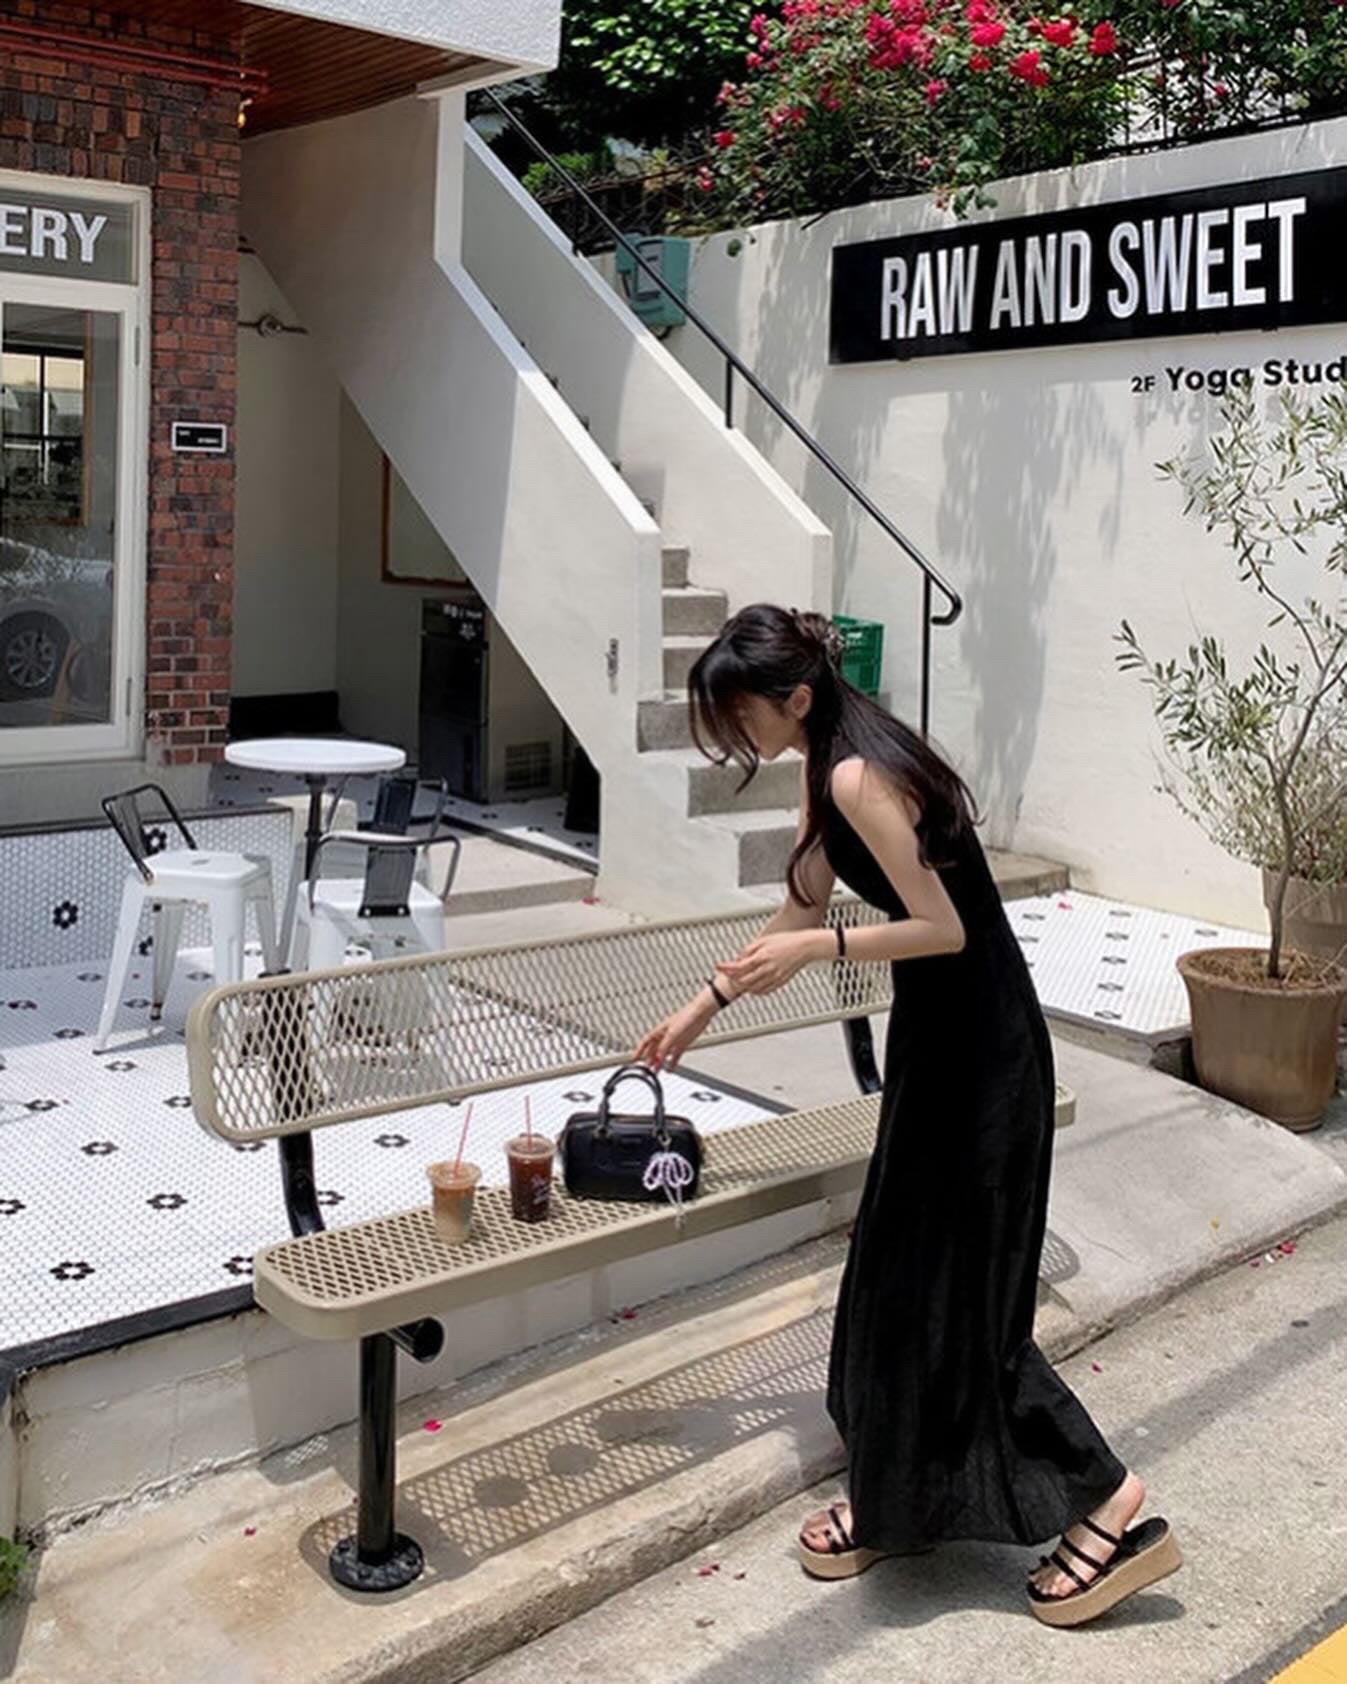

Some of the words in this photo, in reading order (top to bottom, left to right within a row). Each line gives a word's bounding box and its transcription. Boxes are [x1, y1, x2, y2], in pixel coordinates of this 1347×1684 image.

[0, 203, 108, 263] ERY
[880, 245, 979, 341] RAW
[989, 229, 1092, 330] AND
[1107, 196, 1307, 319] SWEET
[1131, 375, 1156, 393] 2F
[1165, 366, 1251, 397] Yoga
[1263, 355, 1347, 386] Stud
